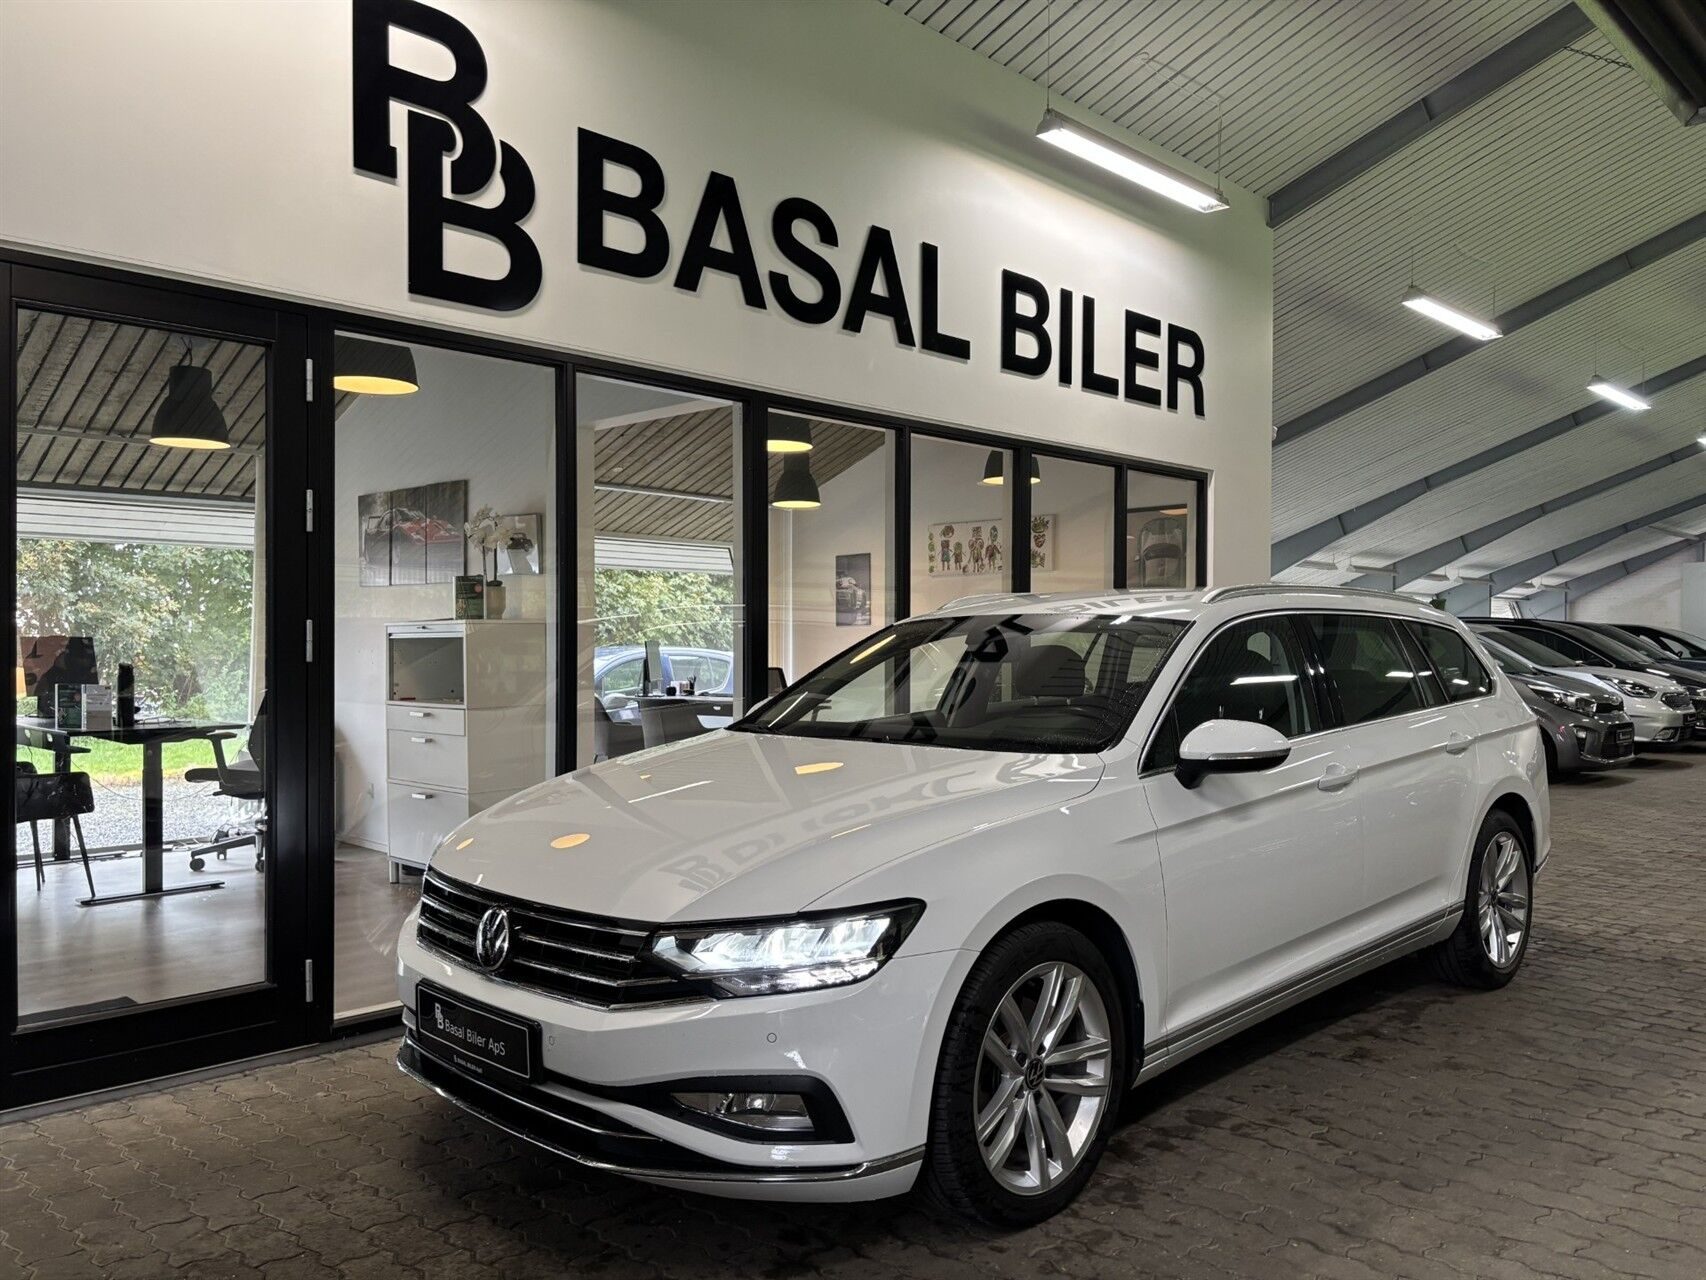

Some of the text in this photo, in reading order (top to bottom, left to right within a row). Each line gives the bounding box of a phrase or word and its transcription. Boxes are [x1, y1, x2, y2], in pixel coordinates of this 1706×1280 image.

[577, 126, 1205, 417] BASAL BILER
[445, 1018, 506, 1056] Basal Biler ApS
